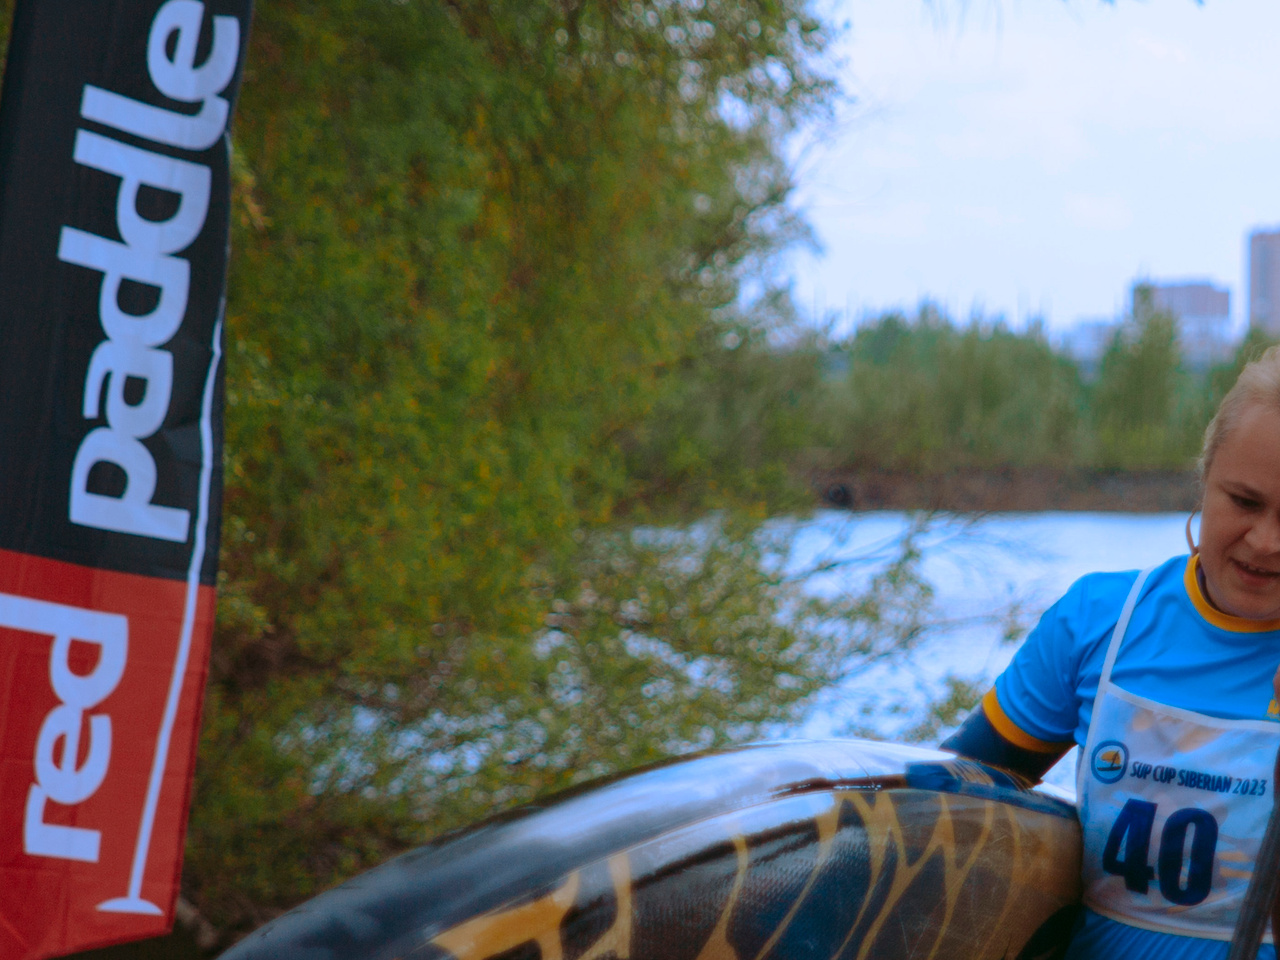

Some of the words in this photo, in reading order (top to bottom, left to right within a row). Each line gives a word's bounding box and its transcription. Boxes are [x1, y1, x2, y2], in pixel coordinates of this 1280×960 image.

[57, 0, 241, 542] paddle
[0, 594, 128, 863] red
[1130, 761, 1152, 778] SUP
[1153, 765, 1176, 784] CUP
[1177, 770, 1232, 792] SIBERIAN
[1233, 779, 1268, 796] 2023
[1102, 798, 1219, 906] 40
